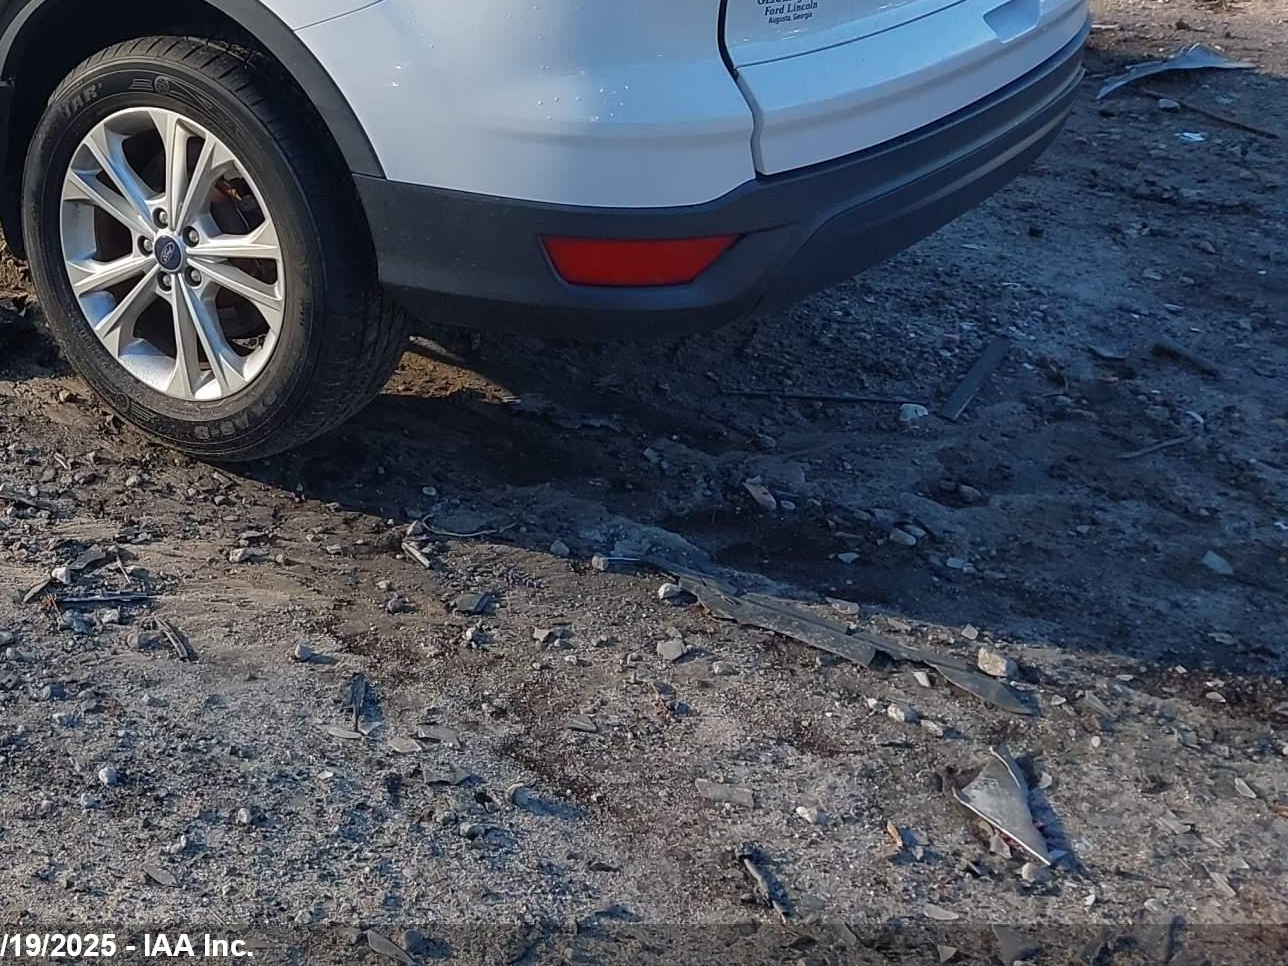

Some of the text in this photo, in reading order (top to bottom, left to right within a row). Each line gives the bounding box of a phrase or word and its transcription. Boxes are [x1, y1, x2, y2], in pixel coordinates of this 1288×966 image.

[764, 0, 818, 16] Ford Lincoln
[793, 12, 813, 21] Georgia
